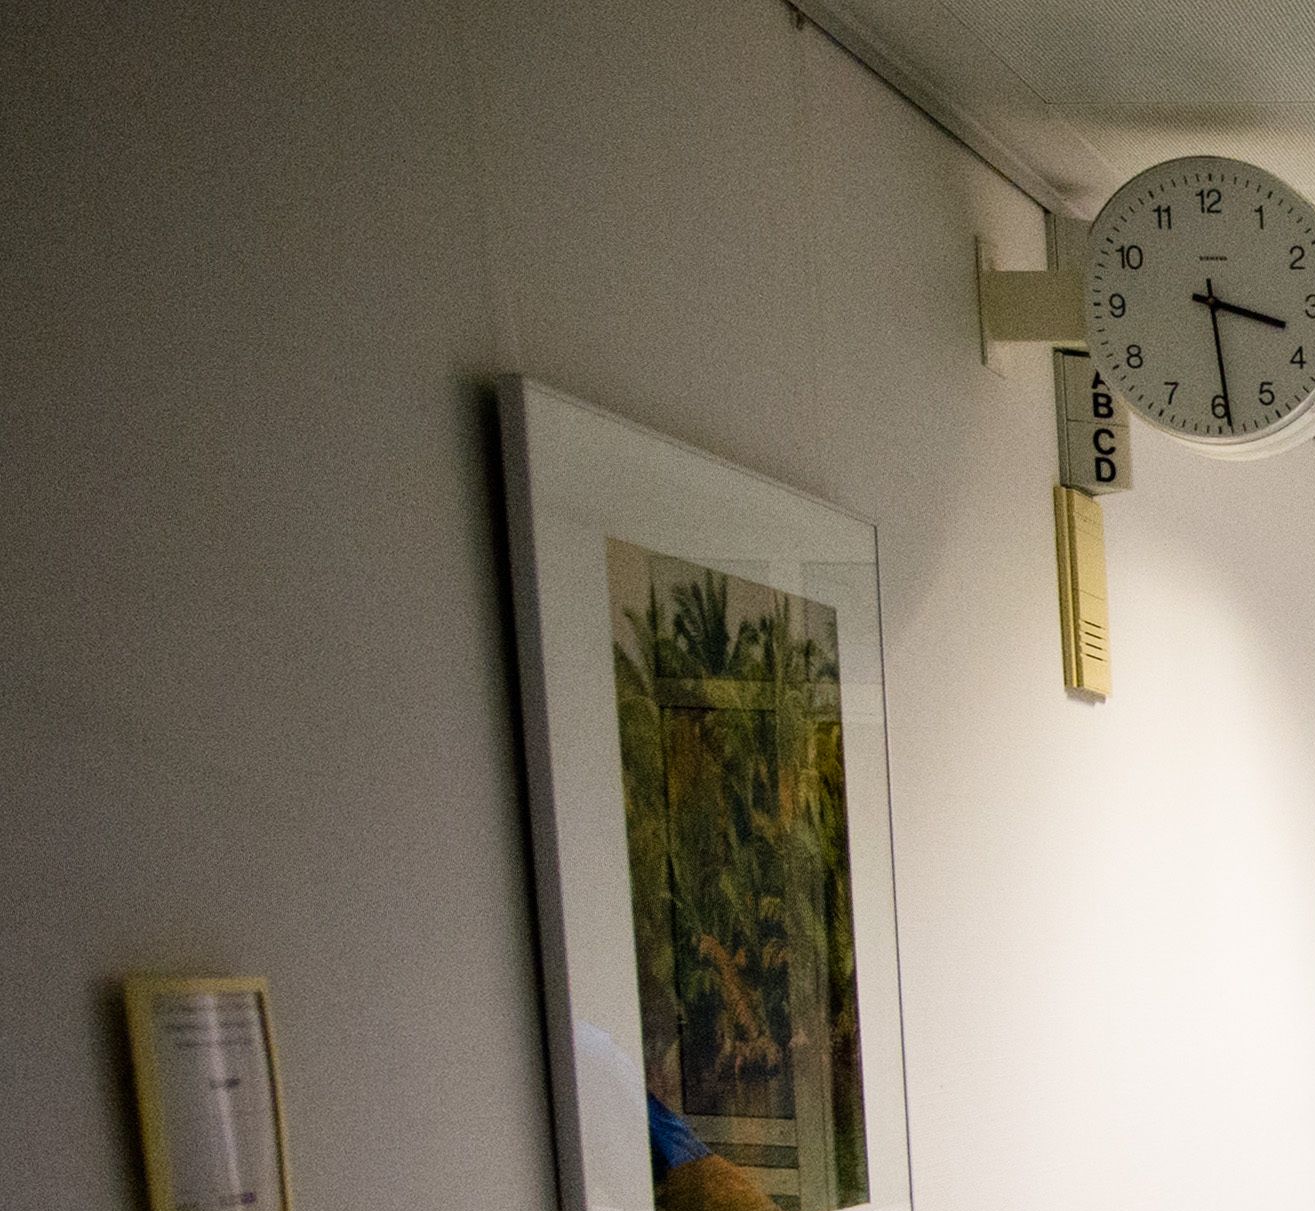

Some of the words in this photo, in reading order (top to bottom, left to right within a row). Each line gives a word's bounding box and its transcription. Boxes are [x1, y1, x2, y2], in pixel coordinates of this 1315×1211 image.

[1195, 188, 1222, 214] 12
[1152, 206, 1173, 230] 11
[1254, 206, 1265, 230] 1
[1115, 245, 1145, 271] 10
[1289, 246, 1306, 270] 2
[1108, 293, 1126, 319] 9
[1126, 345, 1144, 369] 8
[1289, 345, 1307, 369] 4
[1091, 369, 1110, 391] A
[1092, 392, 1115, 419] B
[1163, 382, 1179, 405] 7
[1258, 382, 1276, 407] 5
[1211, 396, 1228, 420] 6
[1093, 428, 1116, 456] C
[1094, 457, 1117, 483] D
